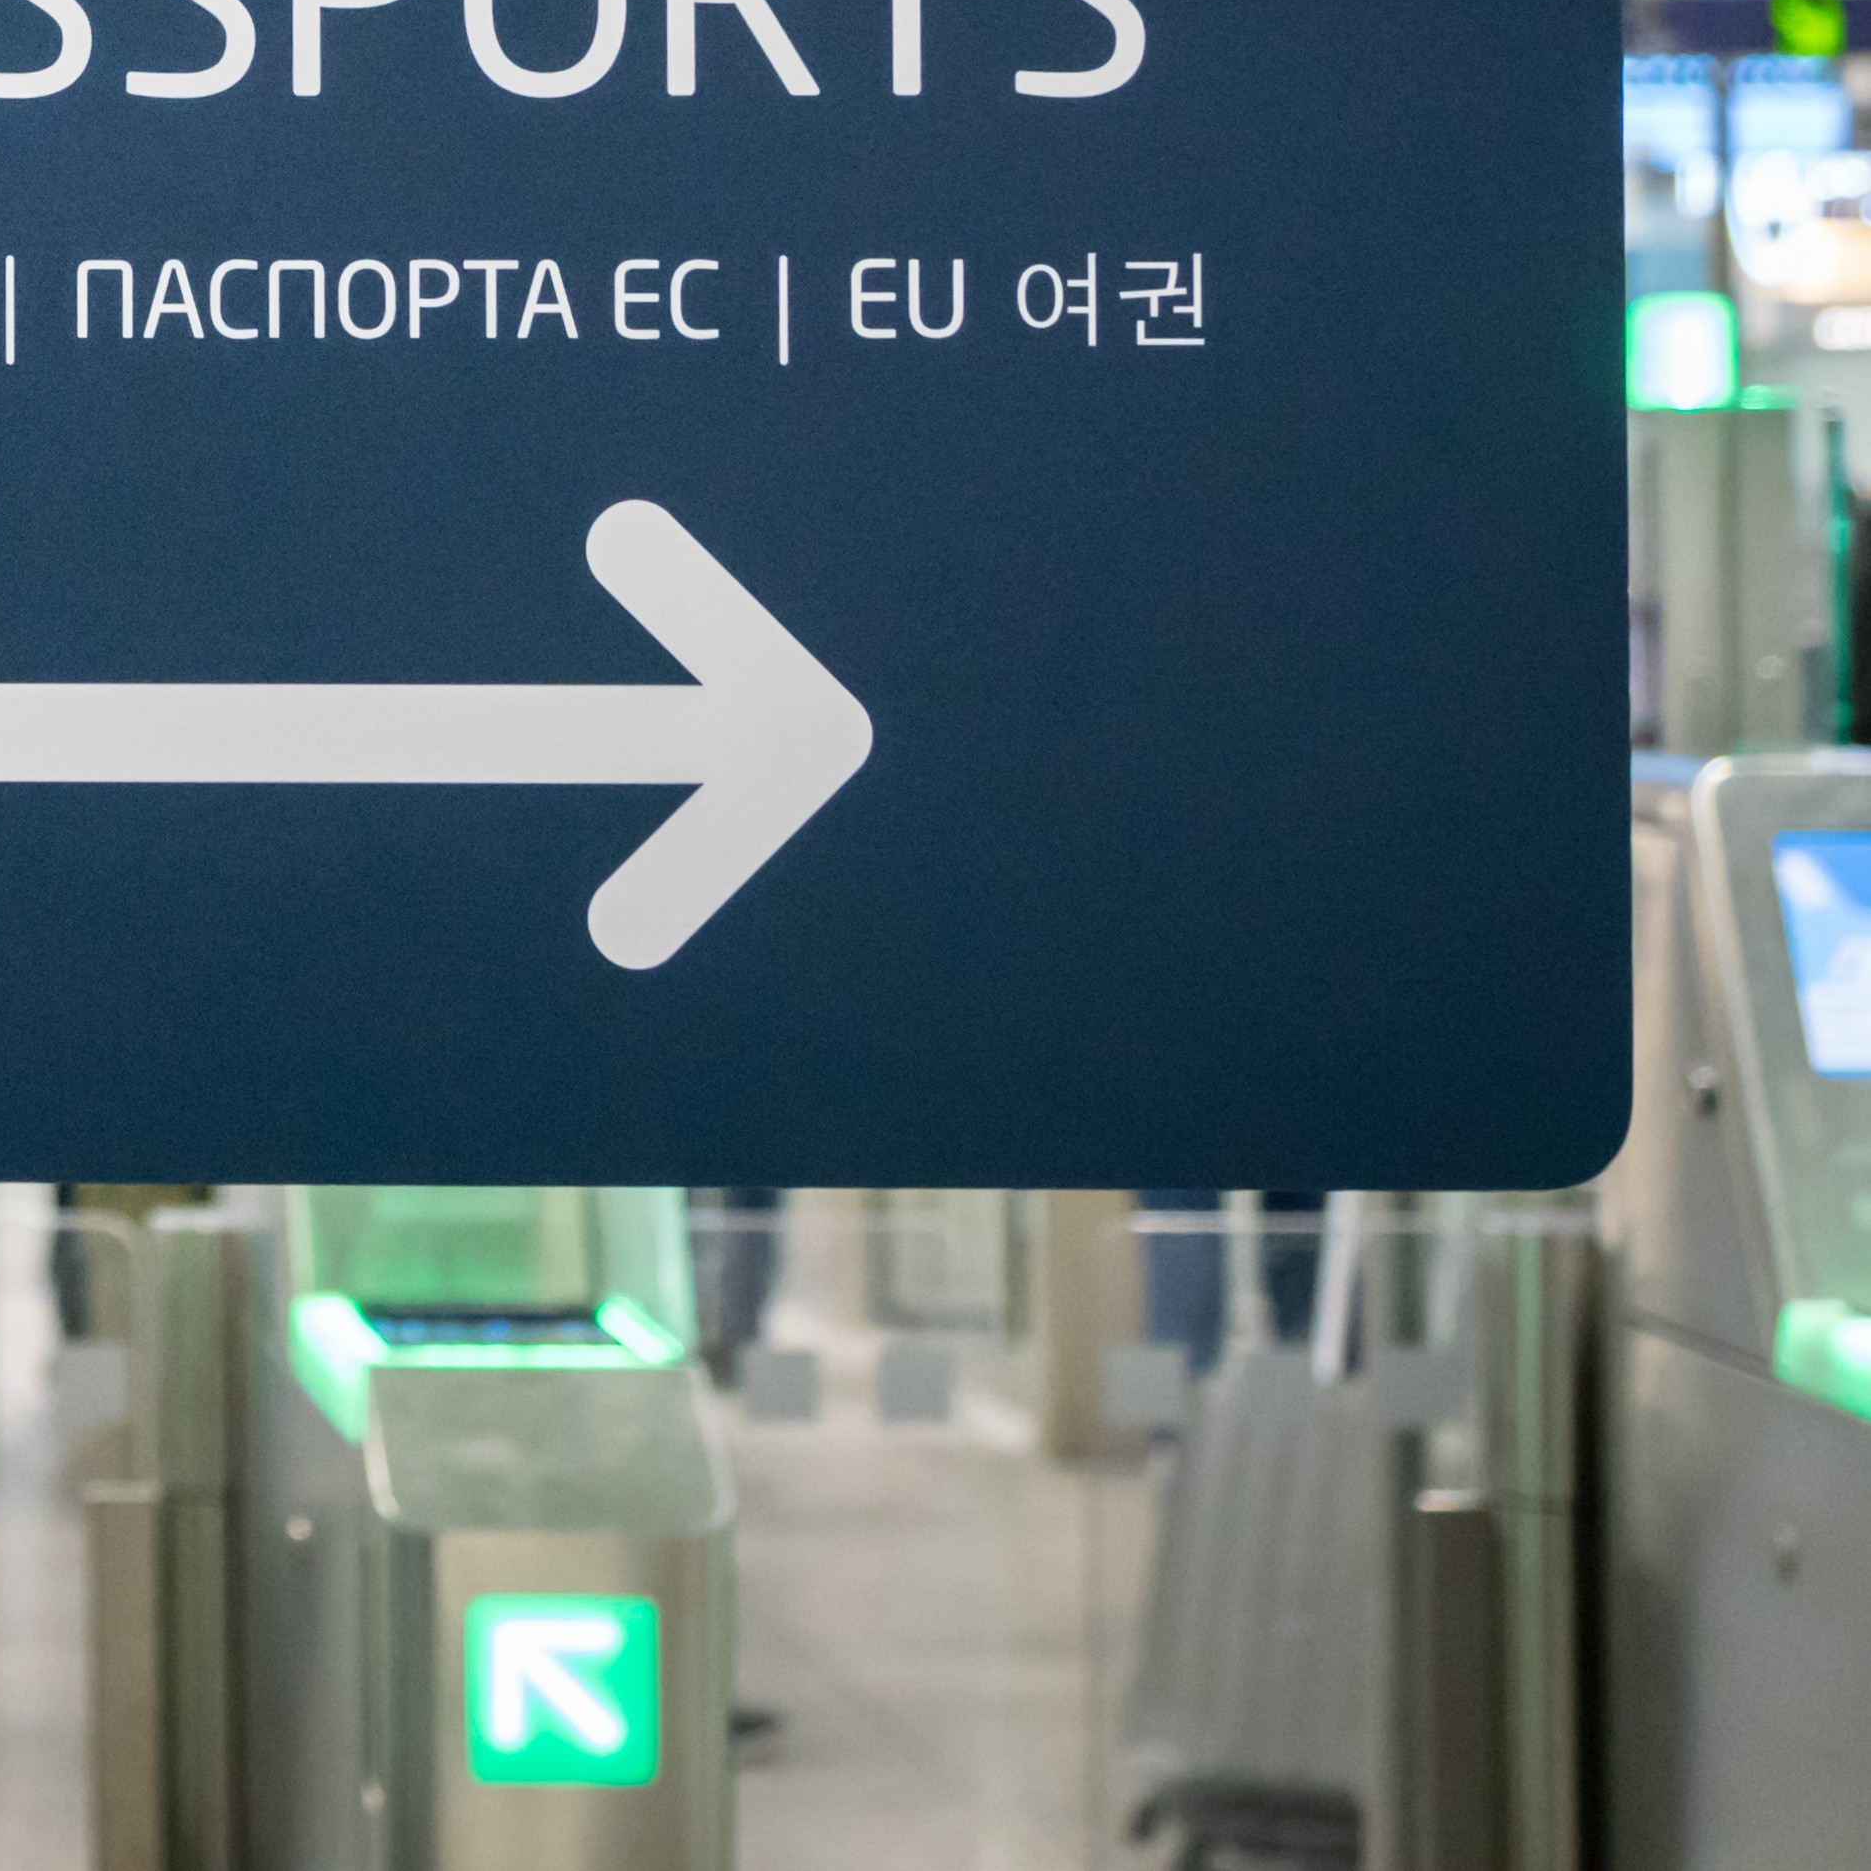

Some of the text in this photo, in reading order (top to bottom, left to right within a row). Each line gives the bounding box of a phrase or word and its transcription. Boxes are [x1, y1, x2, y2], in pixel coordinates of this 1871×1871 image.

[75, 257, 721, 341] ПАСПОРТА ЕС
[849, 256, 966, 340] EU
[1015, 251, 1206, 348] 여권
